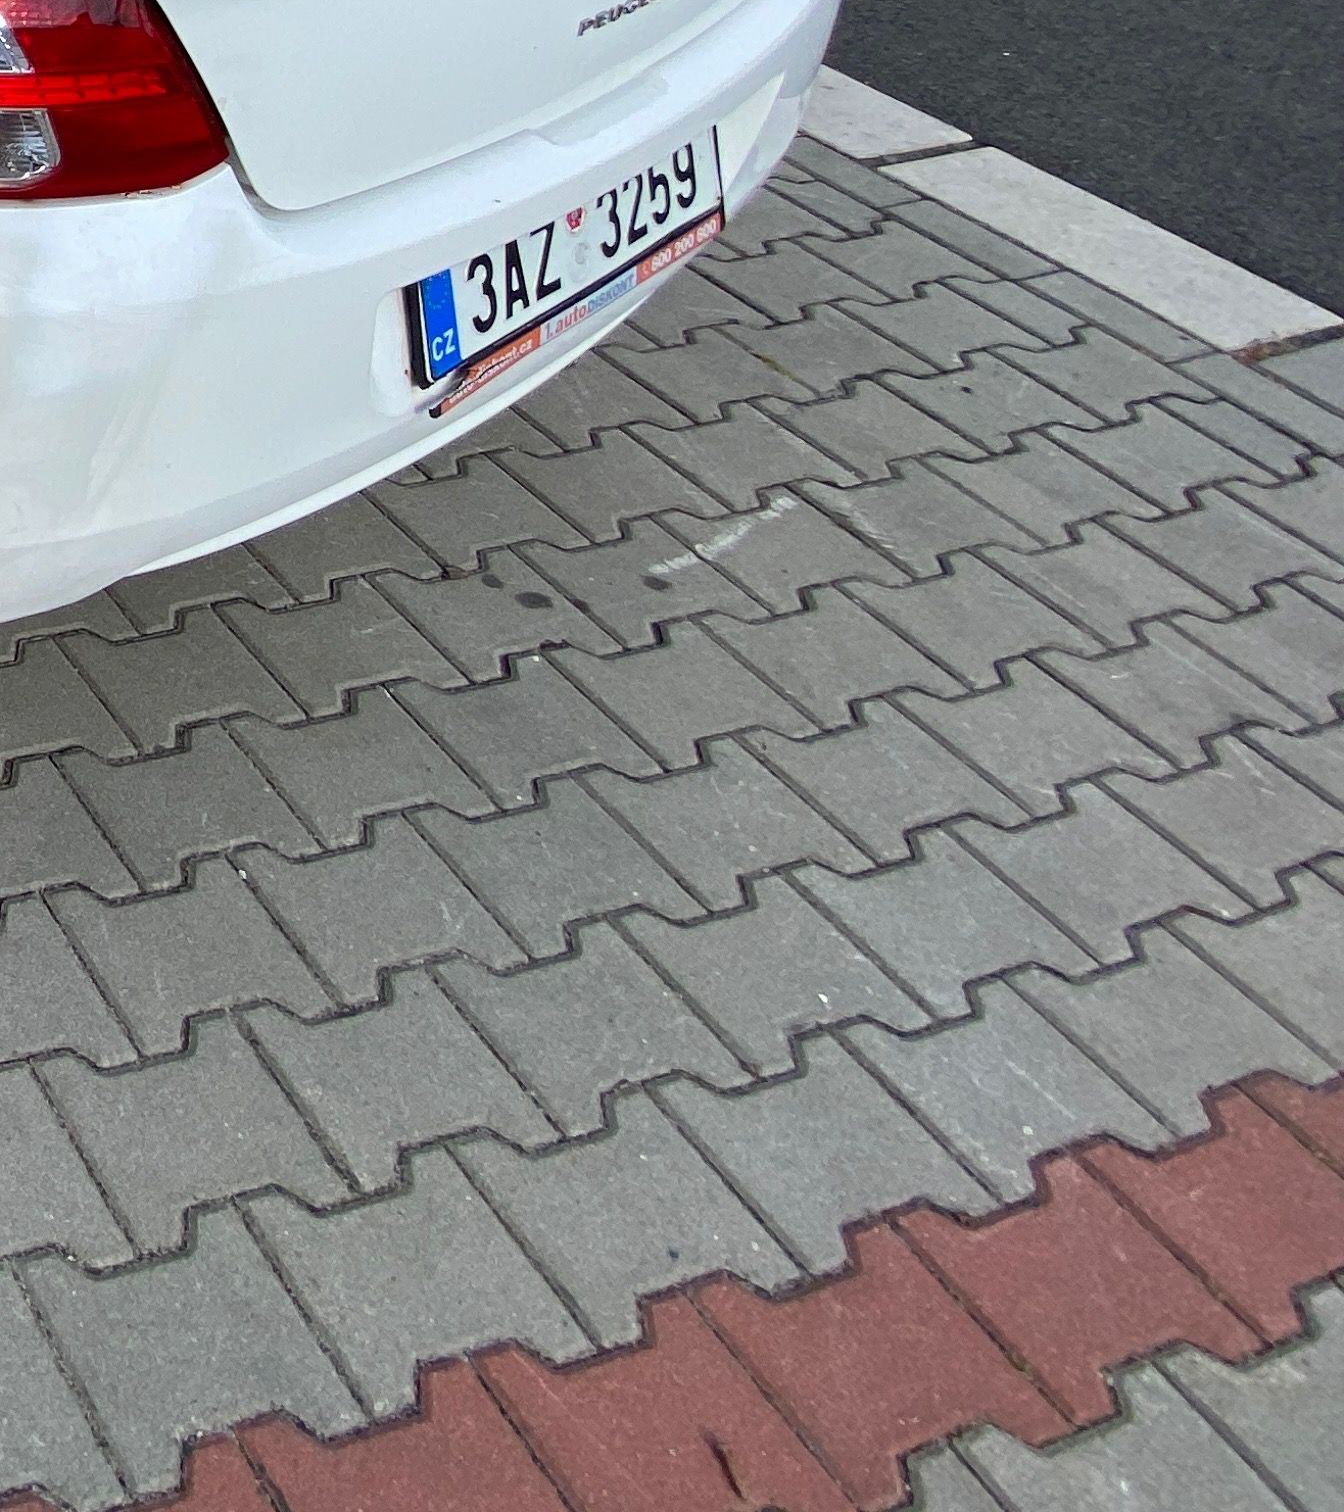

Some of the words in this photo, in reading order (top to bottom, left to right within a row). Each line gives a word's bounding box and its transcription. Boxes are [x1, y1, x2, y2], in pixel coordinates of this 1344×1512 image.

[466, 221, 561, 333] 3AZ
[597, 142, 696, 258] 3259
[432, 327, 456, 362] CZ
